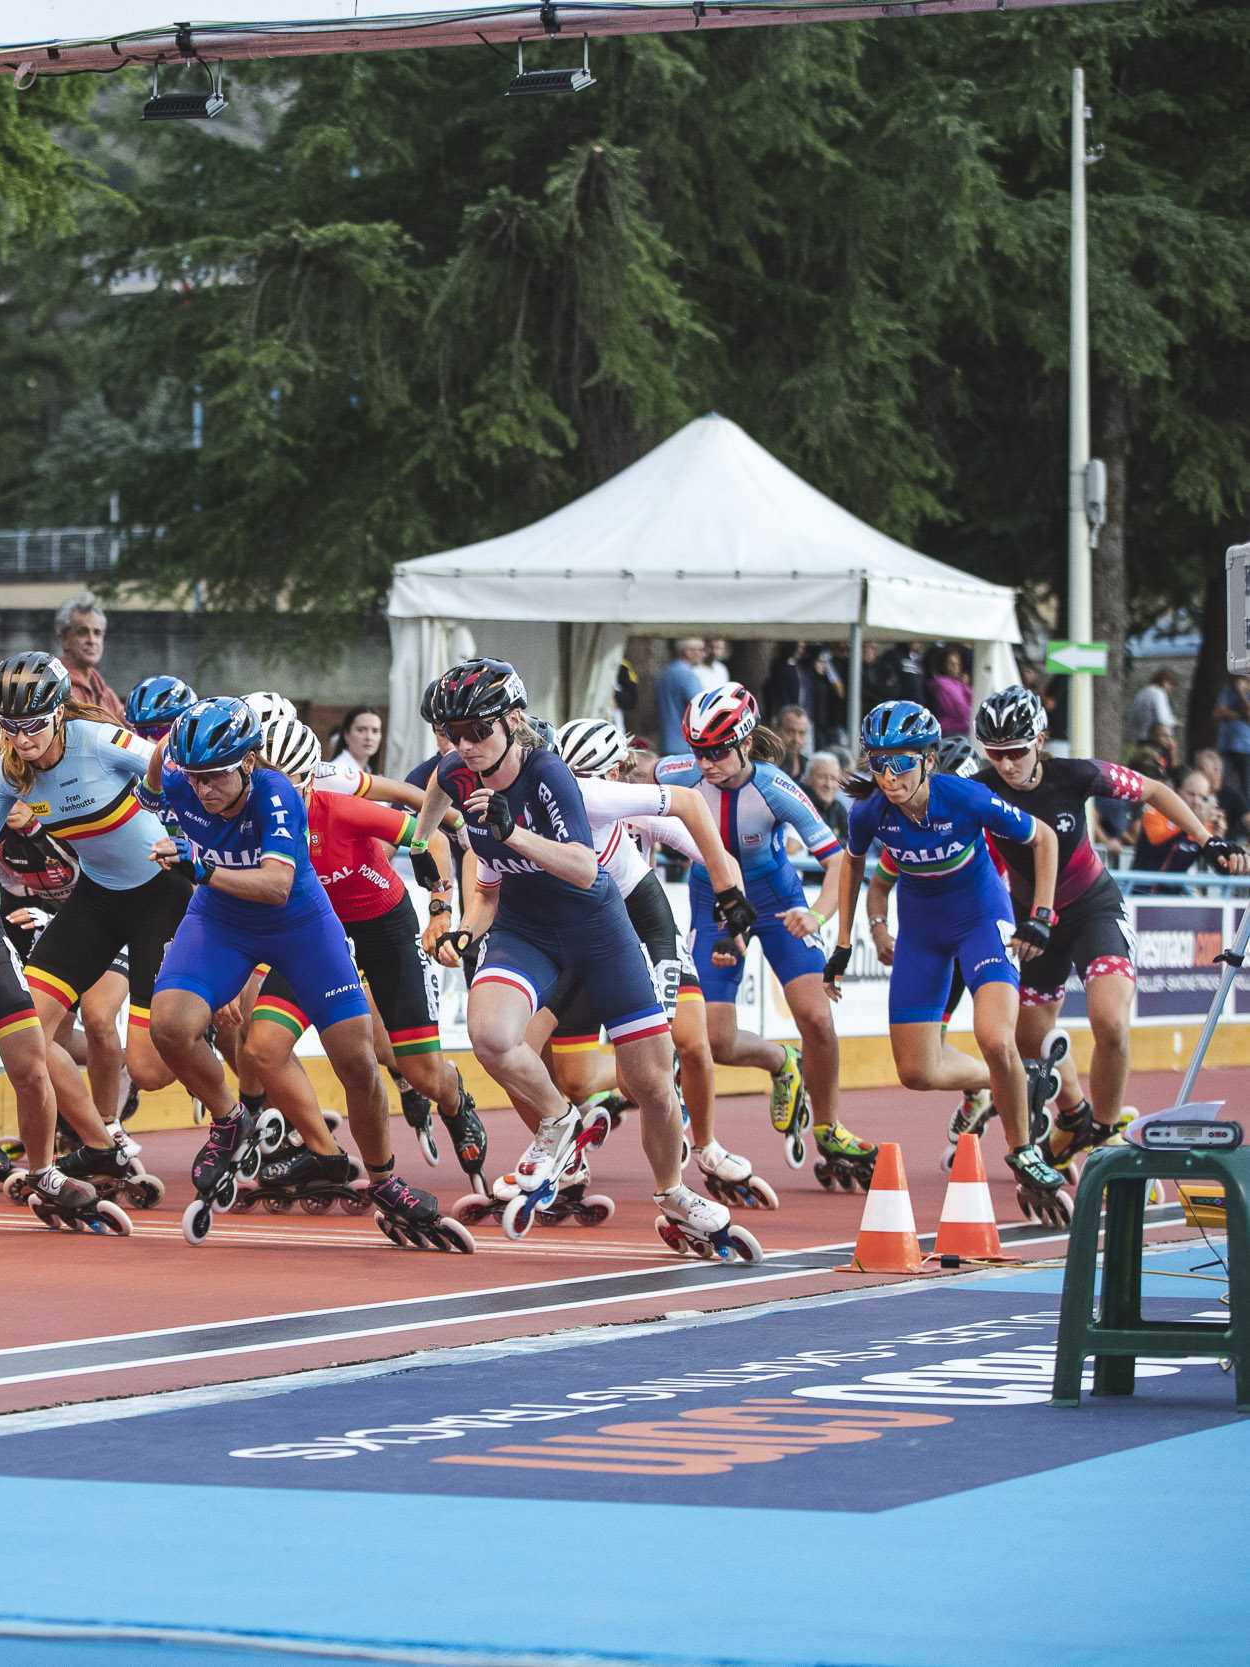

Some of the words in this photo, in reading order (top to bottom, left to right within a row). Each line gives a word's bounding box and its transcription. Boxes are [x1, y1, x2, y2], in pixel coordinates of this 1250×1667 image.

[60, 797, 96, 812] Vanhoutte
[65, 794, 81, 803] Fran
[538, 781, 570, 842] FRANCE
[186, 836, 261, 866] TALIA
[888, 841, 965, 863] TALIA
[358, 864, 390, 889] PORTUGA
[325, 983, 358, 998] REARTU
[228, 1402, 628, 1461] TRACKS
